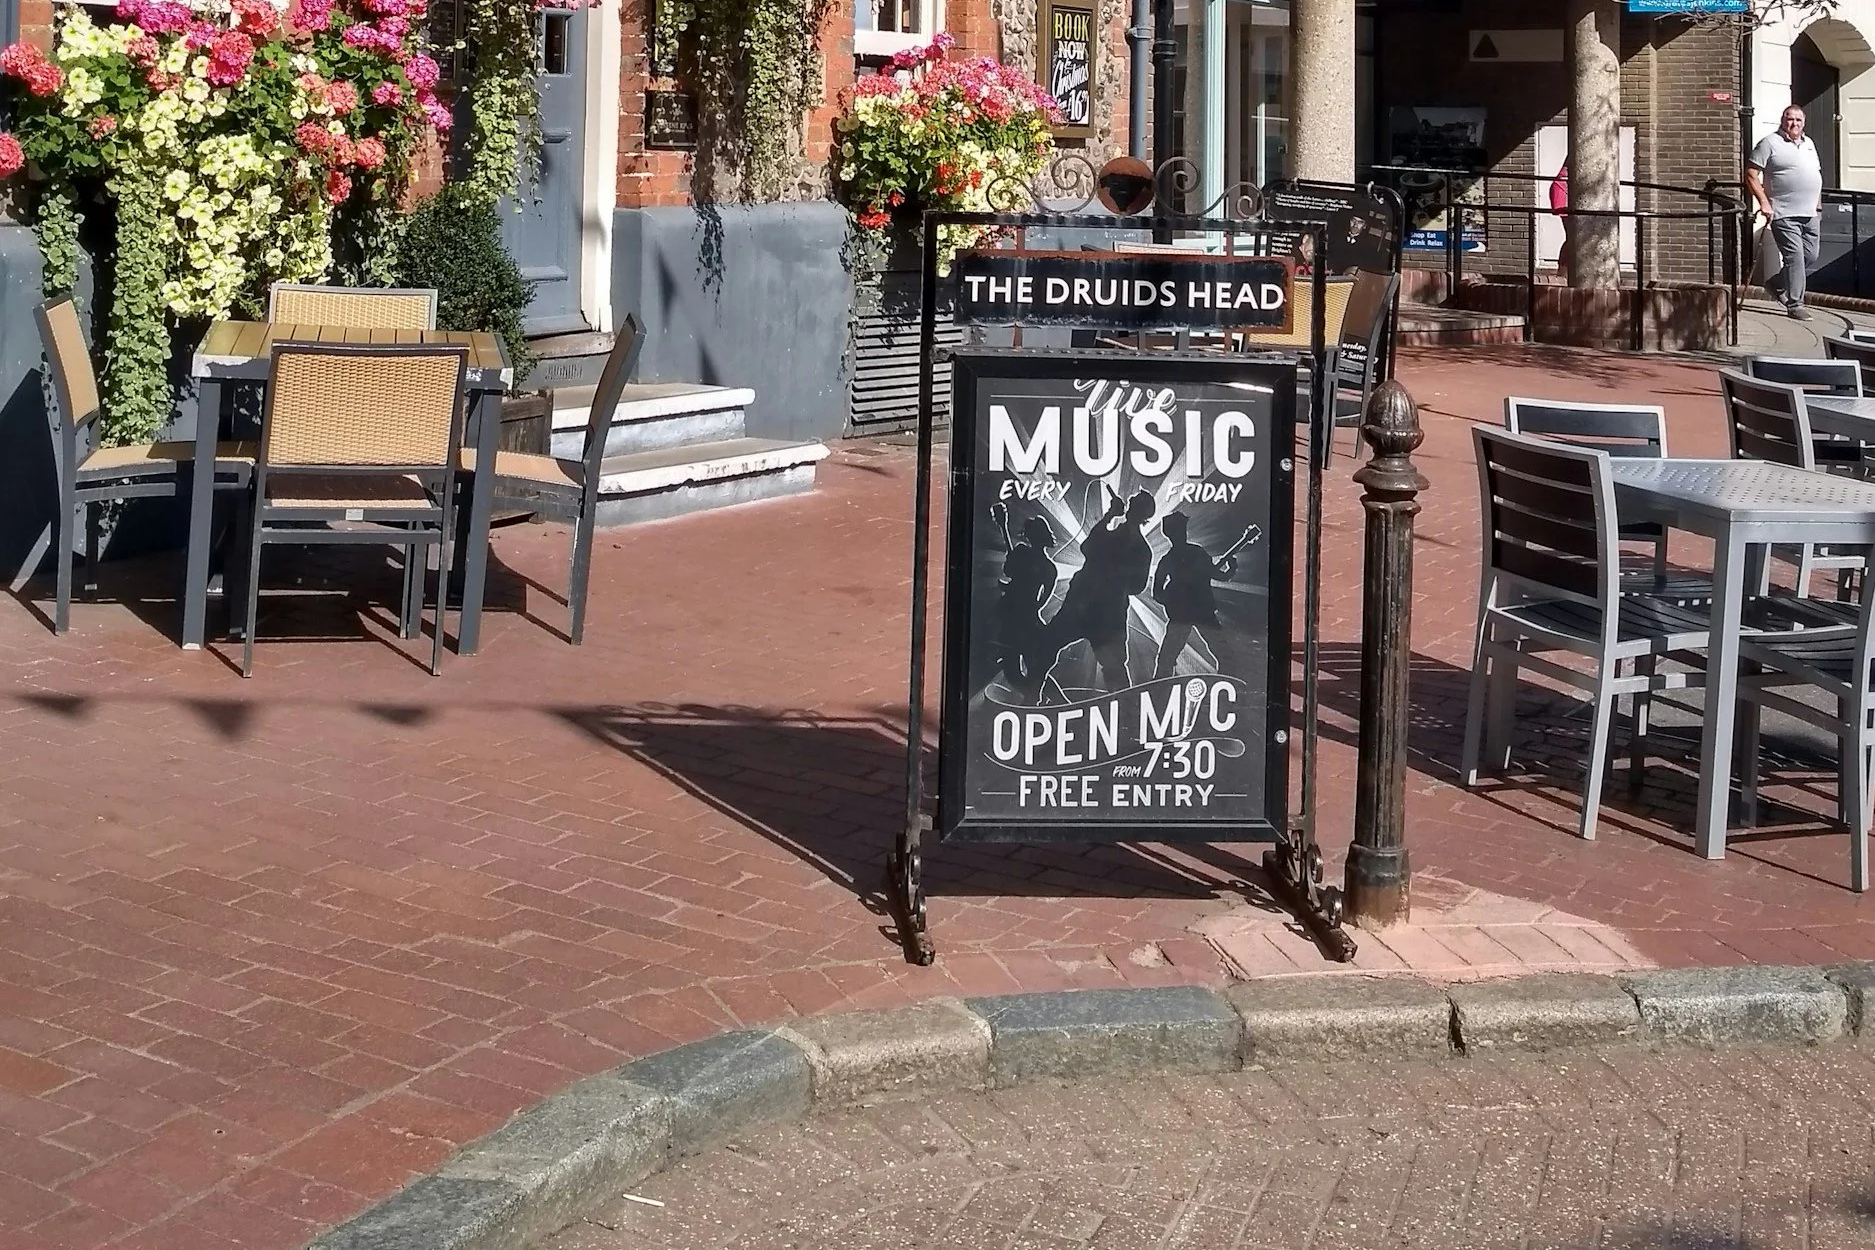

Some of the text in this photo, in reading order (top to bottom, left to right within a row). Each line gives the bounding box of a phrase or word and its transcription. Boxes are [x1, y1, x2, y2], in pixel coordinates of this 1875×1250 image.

[1054, 12, 1090, 42] BOOK
[1058, 40, 1087, 60] NOW
[1052, 60, 1089, 98] Christmas
[1427, 239, 1444, 247] Relax
[964, 275, 1285, 310] THE DRUIDS HEAD
[988, 404, 1255, 478] MUSIC
[999, 479, 1243, 504] EVERY FRIDAY
[992, 700, 1119, 766] OPEN
[1112, 740, 1216, 779] FROM 7:30
[1019, 775, 1215, 807] FREE ENTRY
